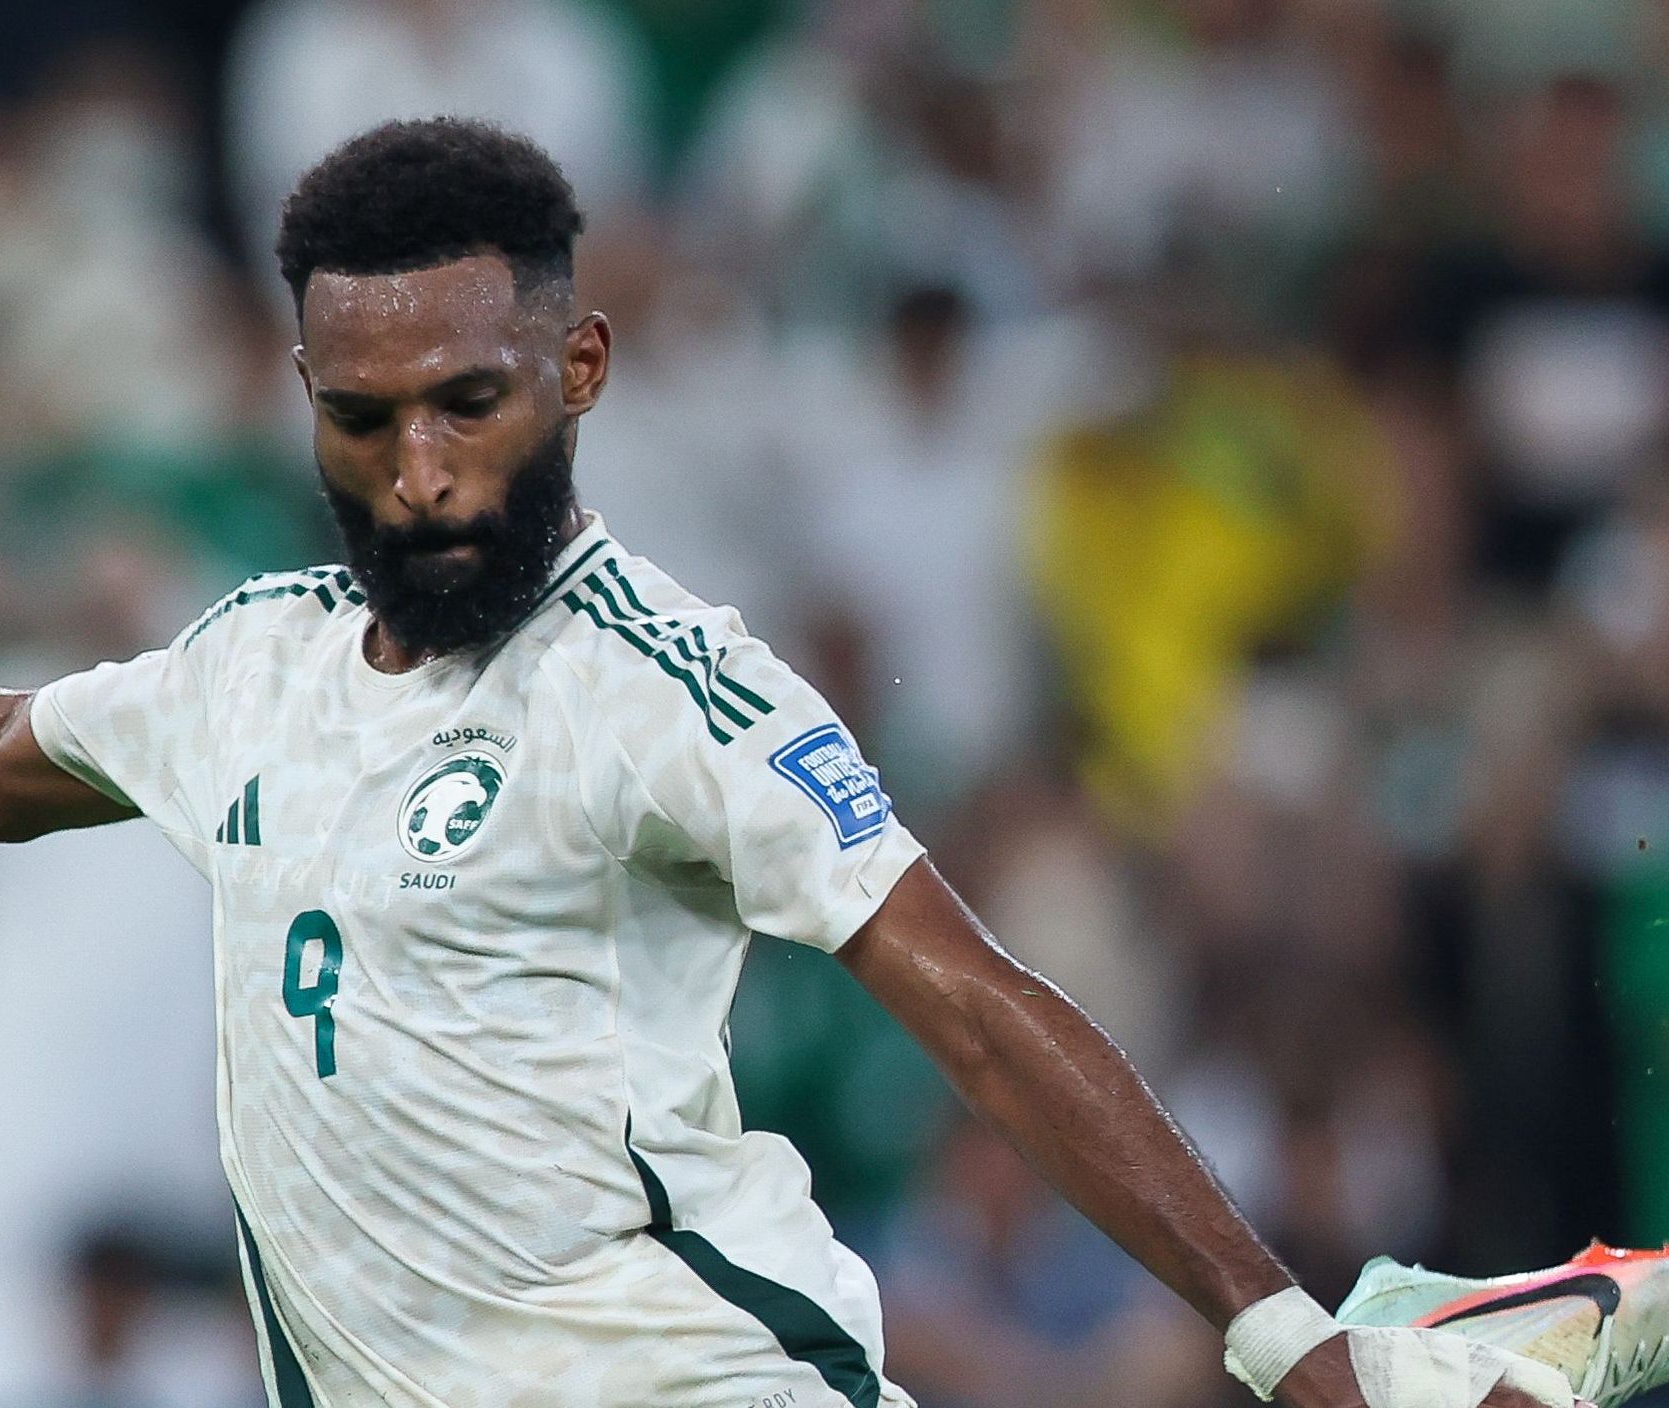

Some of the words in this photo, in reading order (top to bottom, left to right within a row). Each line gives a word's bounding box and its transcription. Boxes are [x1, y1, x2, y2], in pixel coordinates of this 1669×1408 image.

[856, 799, 874, 812] FIFA
[448, 819, 479, 830] SAFF
[399, 872, 456, 890] SAUDI
[282, 909, 343, 1079] 9
